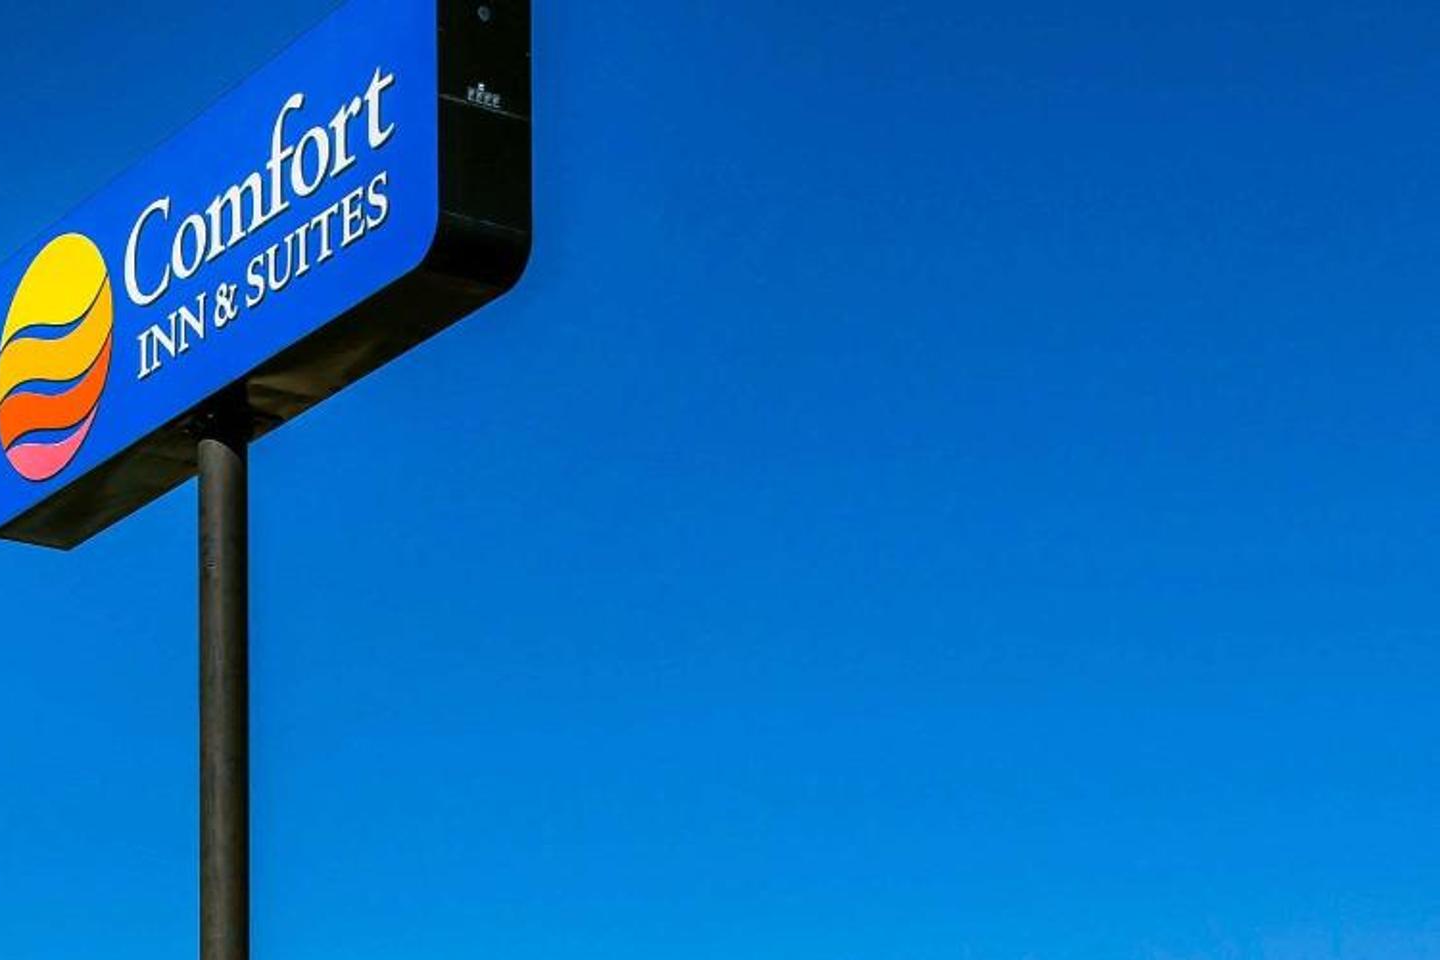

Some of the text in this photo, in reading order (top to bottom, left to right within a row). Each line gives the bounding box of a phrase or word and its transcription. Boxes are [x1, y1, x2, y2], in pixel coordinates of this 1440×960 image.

[123, 66, 396, 306] Comfort
[137, 170, 390, 381] INN & SUITES
